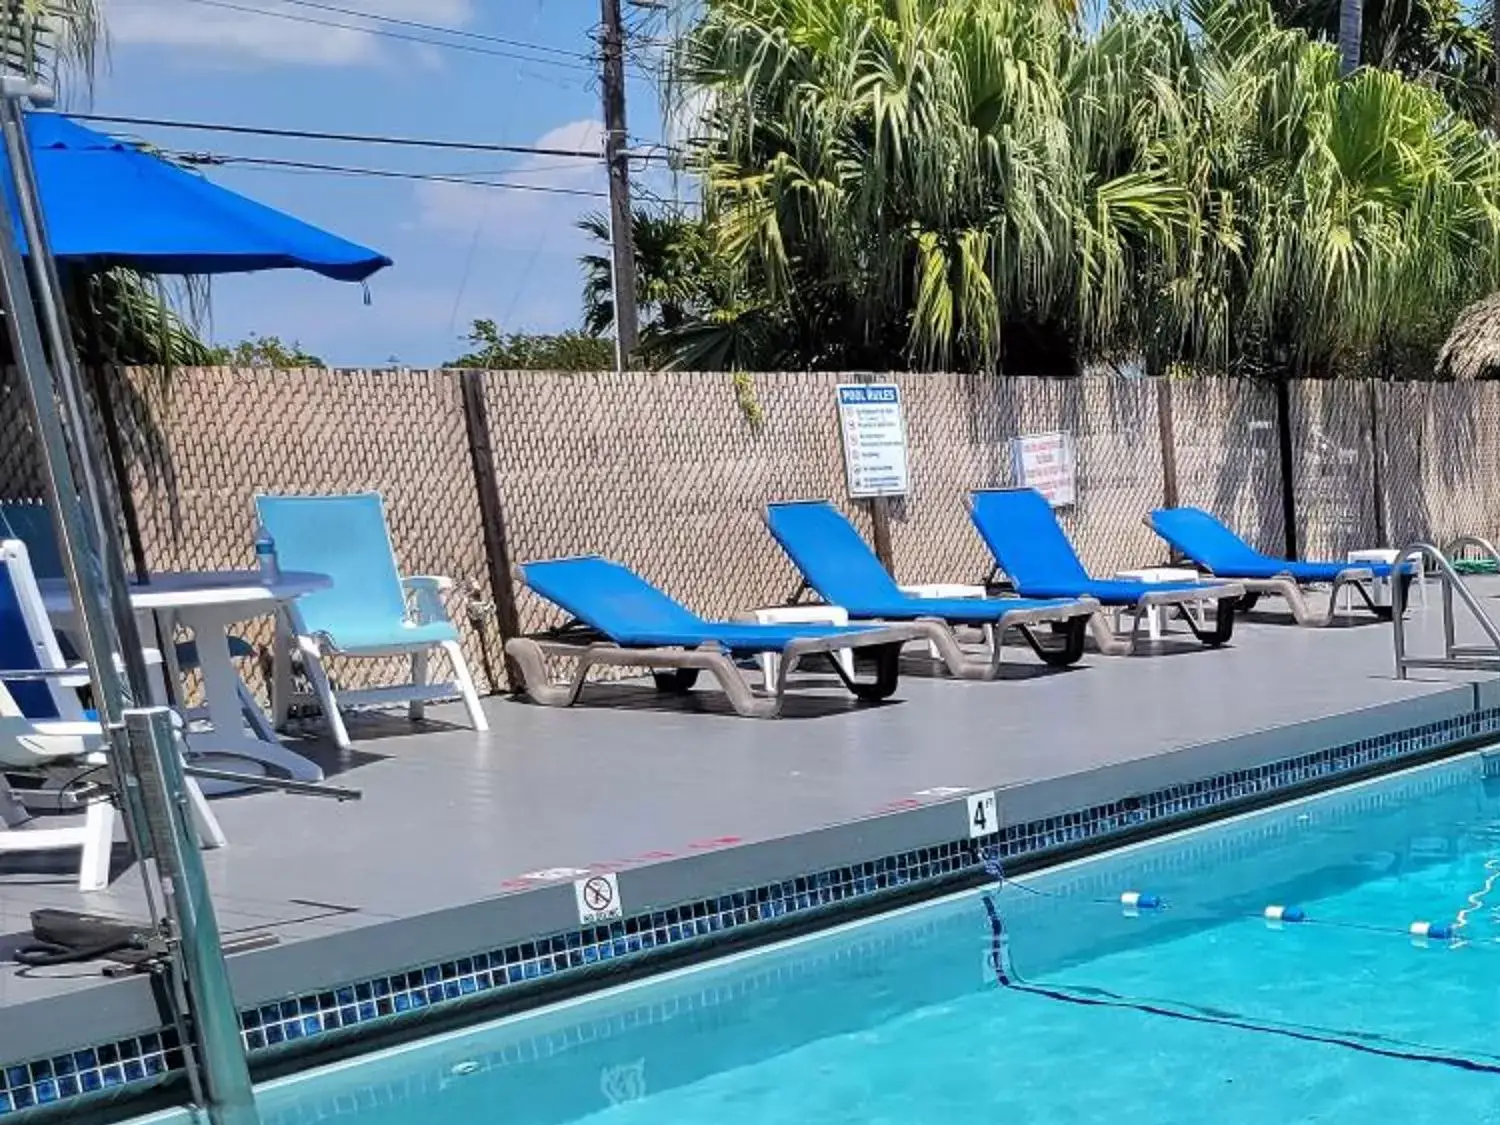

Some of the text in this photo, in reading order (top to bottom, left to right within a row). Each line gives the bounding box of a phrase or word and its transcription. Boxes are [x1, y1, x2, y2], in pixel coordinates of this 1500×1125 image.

[842, 388, 895, 401] POOL RULES
[974, 800, 987, 830] 4
